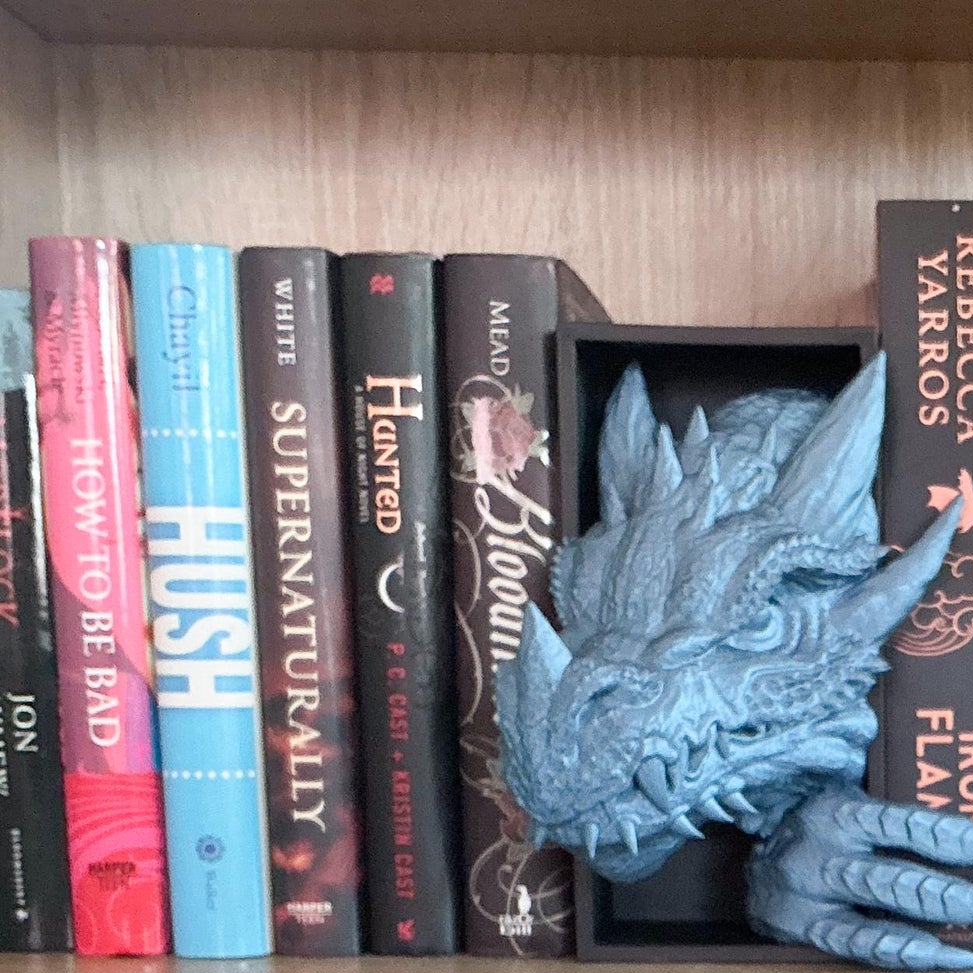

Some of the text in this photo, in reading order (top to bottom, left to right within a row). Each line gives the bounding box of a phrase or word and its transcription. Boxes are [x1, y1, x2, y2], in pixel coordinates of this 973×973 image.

[275, 277, 296, 367] WHITE
[489, 301, 510, 376] MEAD
[917, 251, 950, 426] YARROS
[70, 438, 119, 747] HOW TO BE BAD
[145, 505, 254, 709] HUSH
[270, 400, 326, 833] SUPERNATURALLY
[6, 692, 39, 752] JON
[915, 708, 955, 810] FLA
